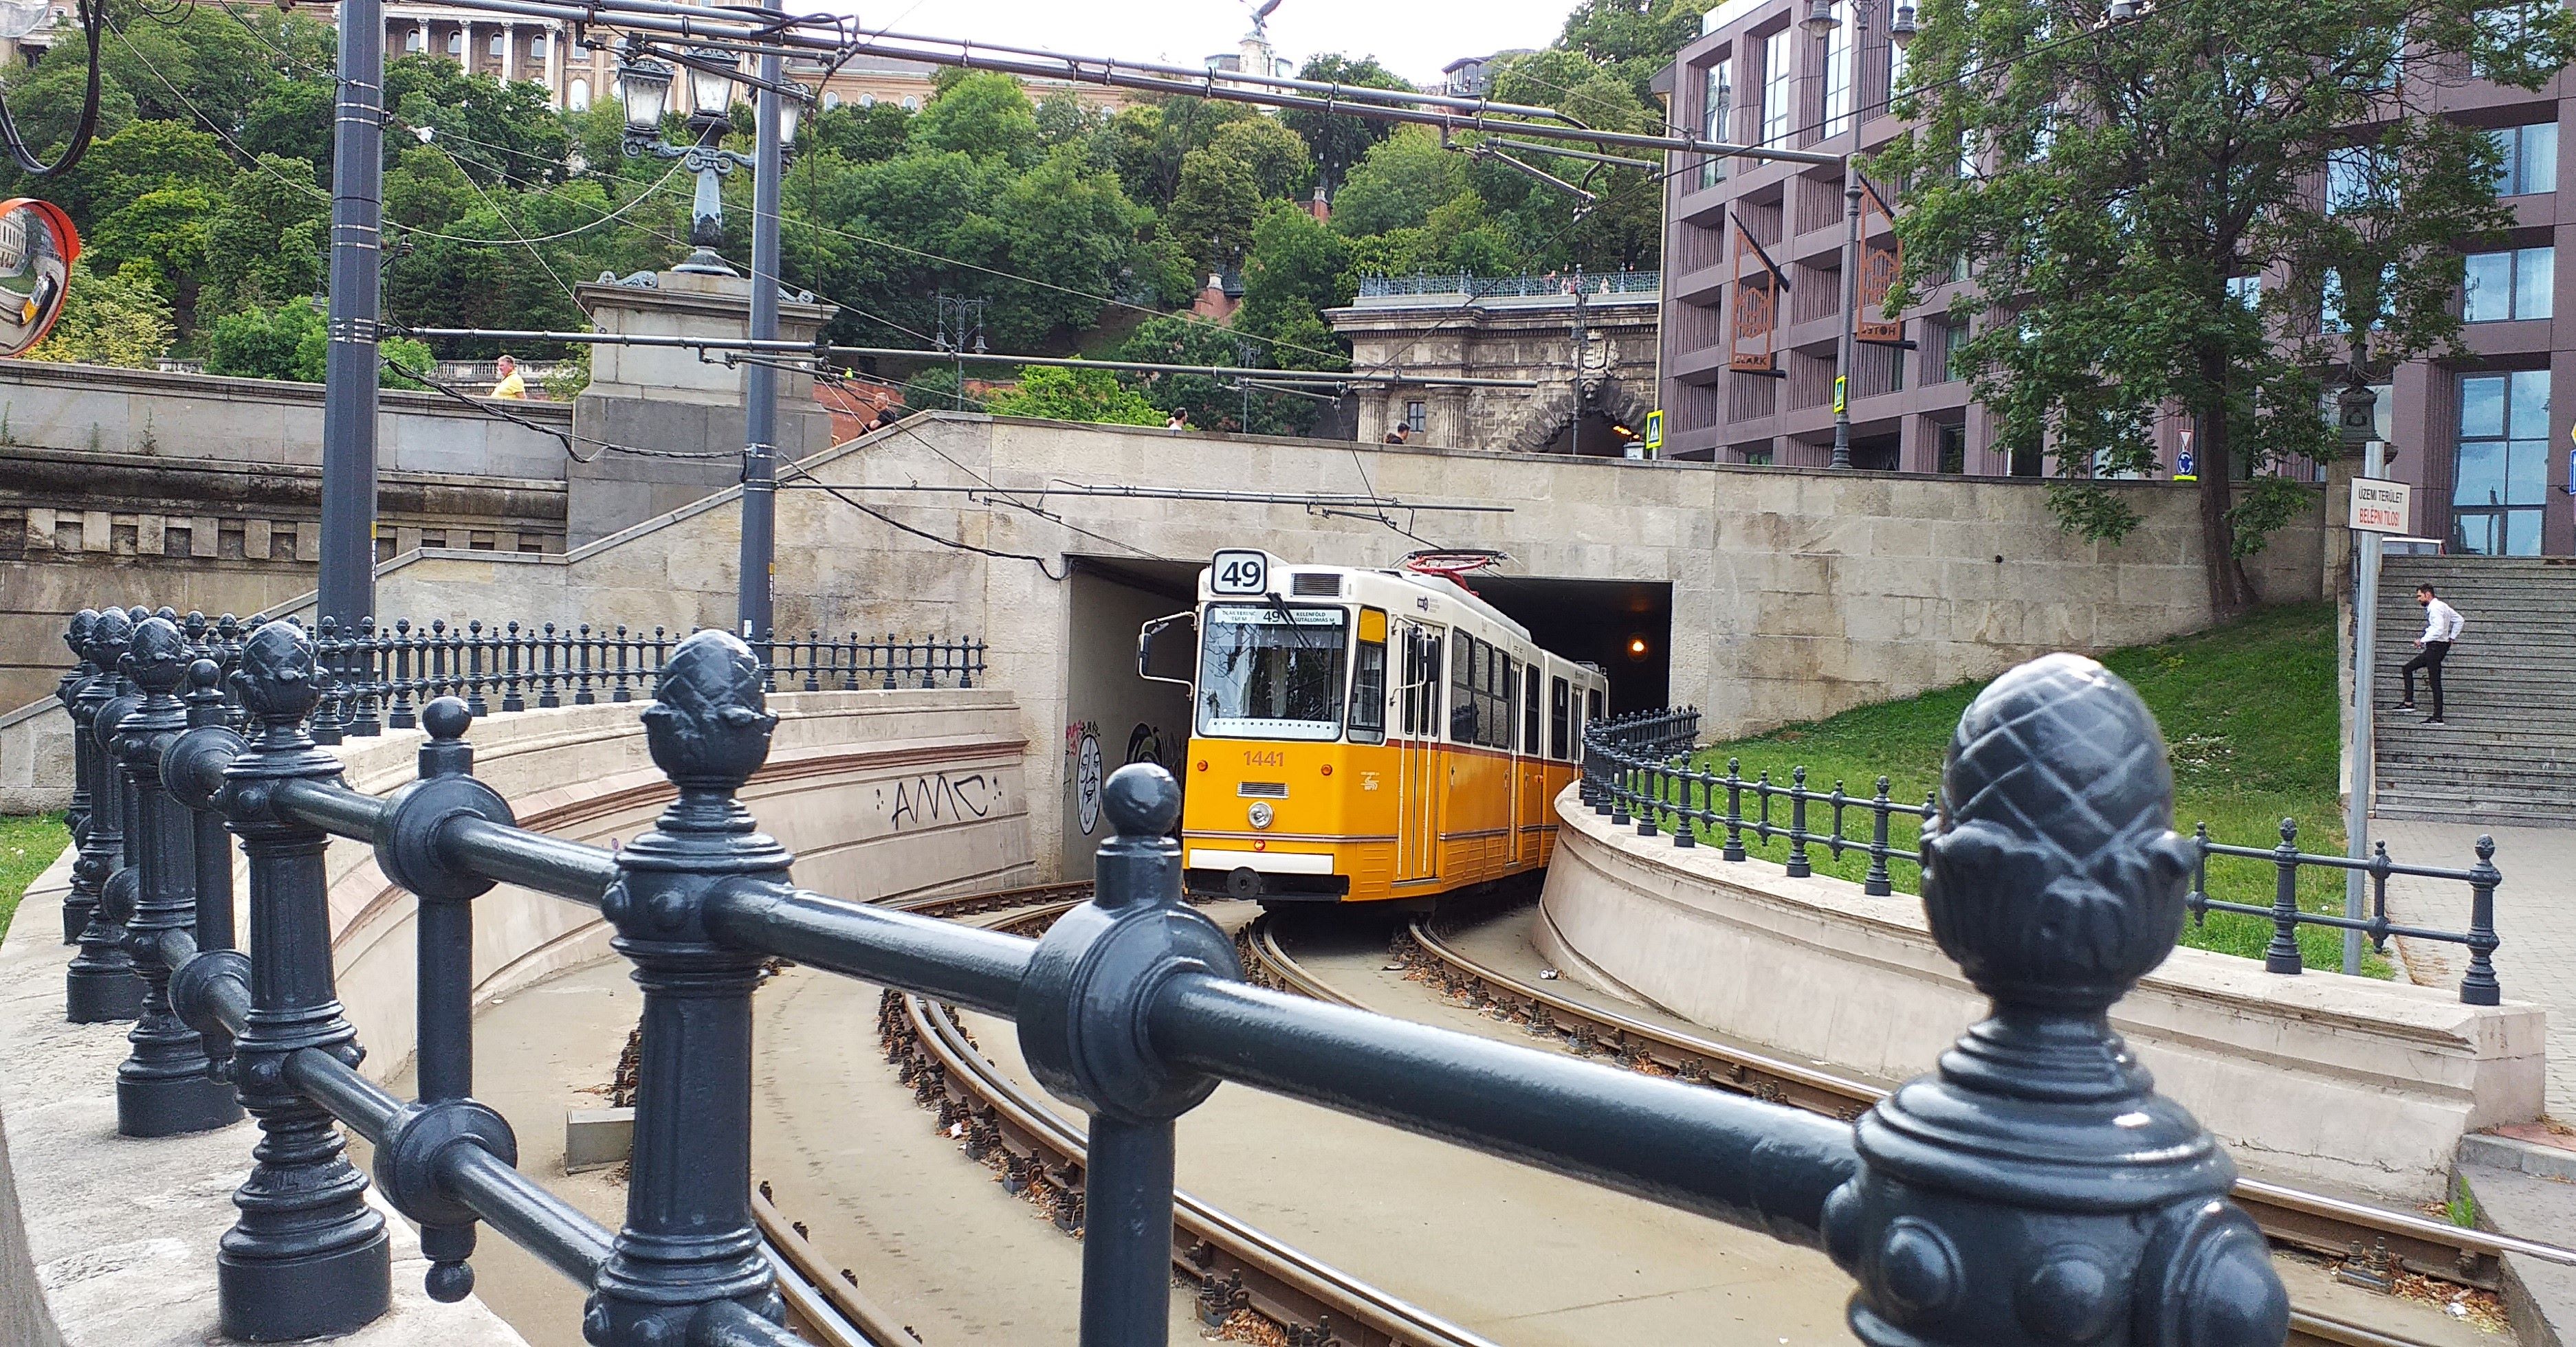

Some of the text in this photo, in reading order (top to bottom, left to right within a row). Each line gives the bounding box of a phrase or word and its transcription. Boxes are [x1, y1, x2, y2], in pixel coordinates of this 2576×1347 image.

[1735, 355, 1767, 366] CLARK
[2359, 486, 2403, 503] ÜZEMI TERÜLET
[1221, 561, 1261, 588] 49
[1263, 611, 1280, 622] 49
[1244, 750, 1284, 766] 1441
